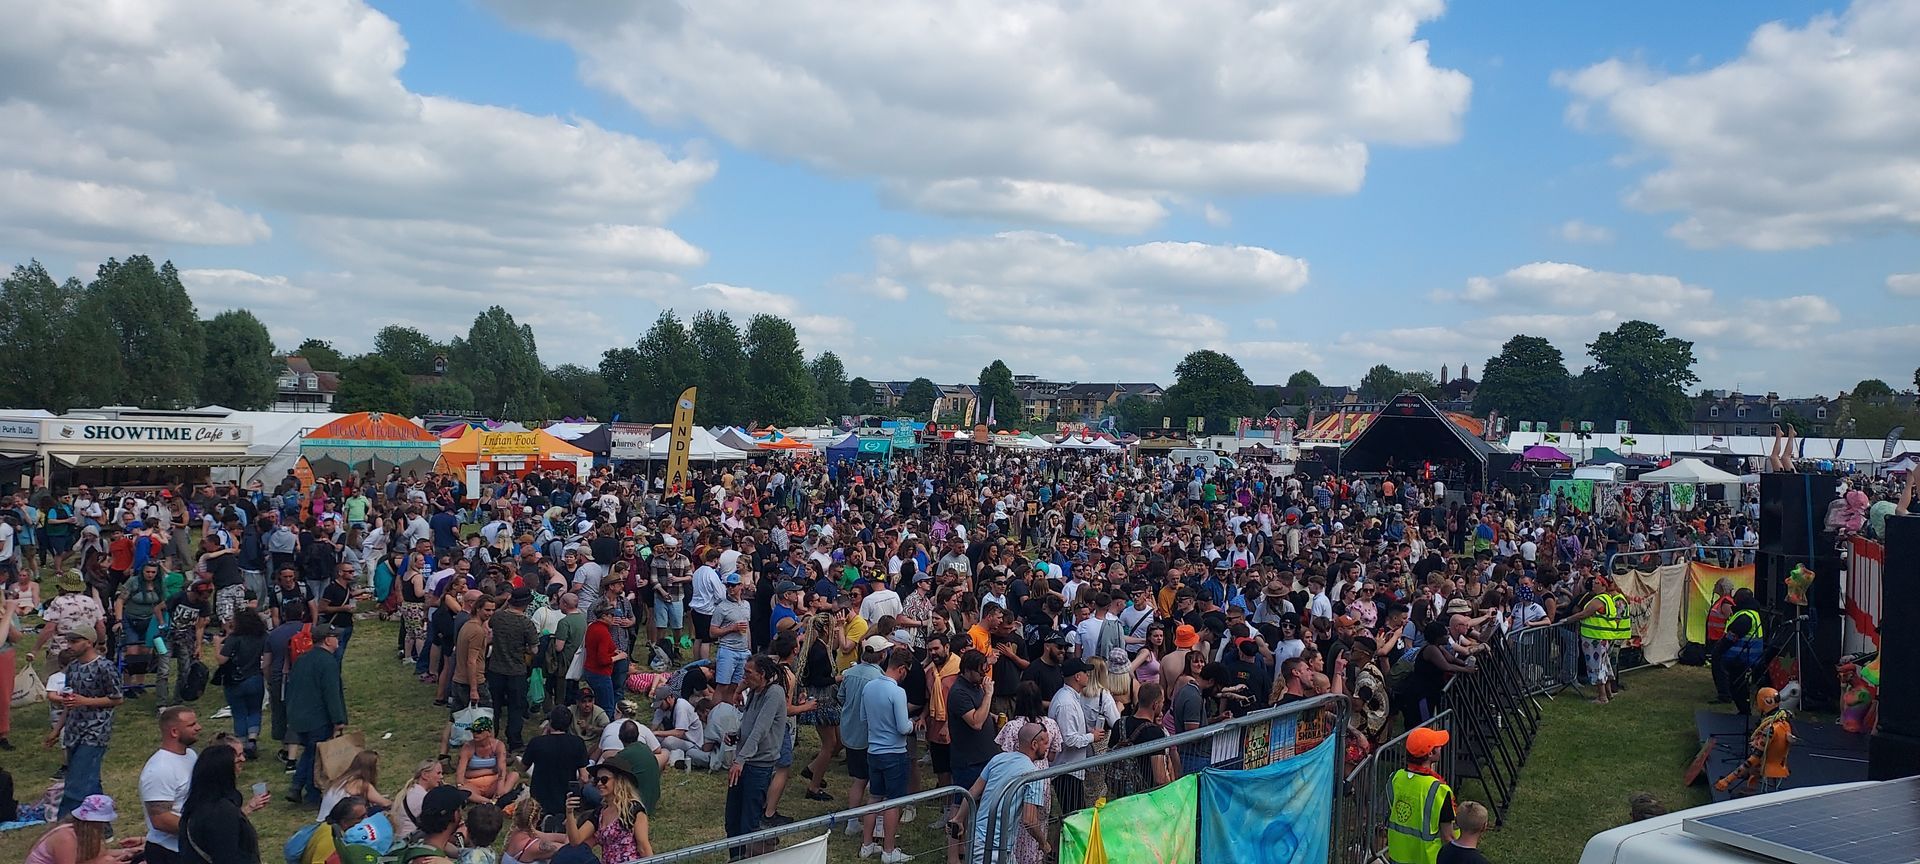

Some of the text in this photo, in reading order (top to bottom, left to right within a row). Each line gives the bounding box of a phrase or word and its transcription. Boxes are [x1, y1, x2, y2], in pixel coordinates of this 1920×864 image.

[83, 425, 224, 442] SHOWTIME Café
[328, 423, 420, 438] VEGAN & VEGETARIAN
[483, 433, 538, 446] Indian Food
[671, 411, 688, 485] INDIA
